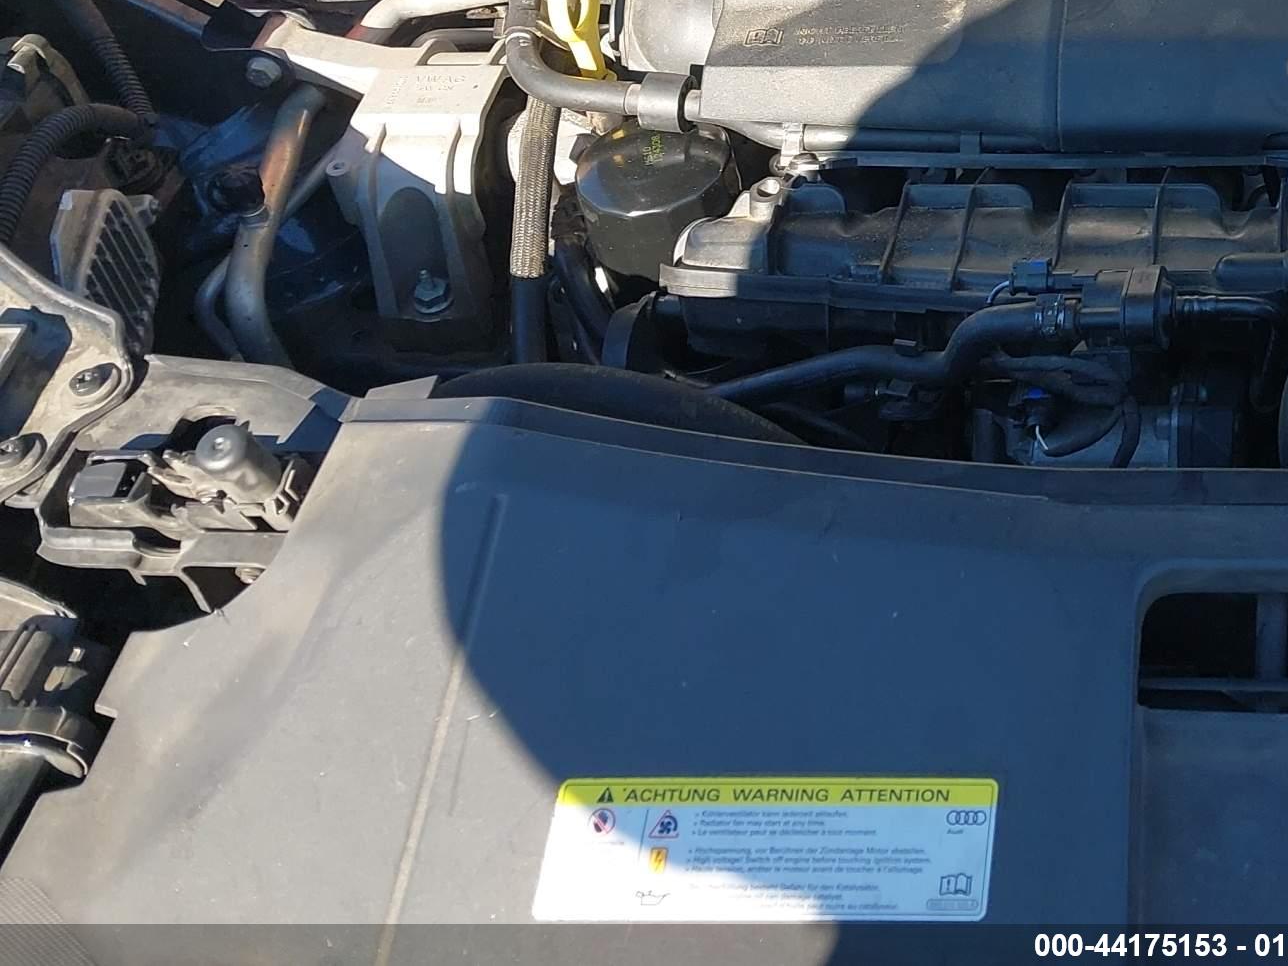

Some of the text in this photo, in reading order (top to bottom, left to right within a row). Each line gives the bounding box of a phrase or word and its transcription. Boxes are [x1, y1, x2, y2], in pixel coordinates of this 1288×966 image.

[624, 788, 951, 803] ACHTUNG WARNING ATTENTION
[747, 819, 762, 828] may
[866, 847, 889, 856] Motor
[694, 856, 711, 865] High
